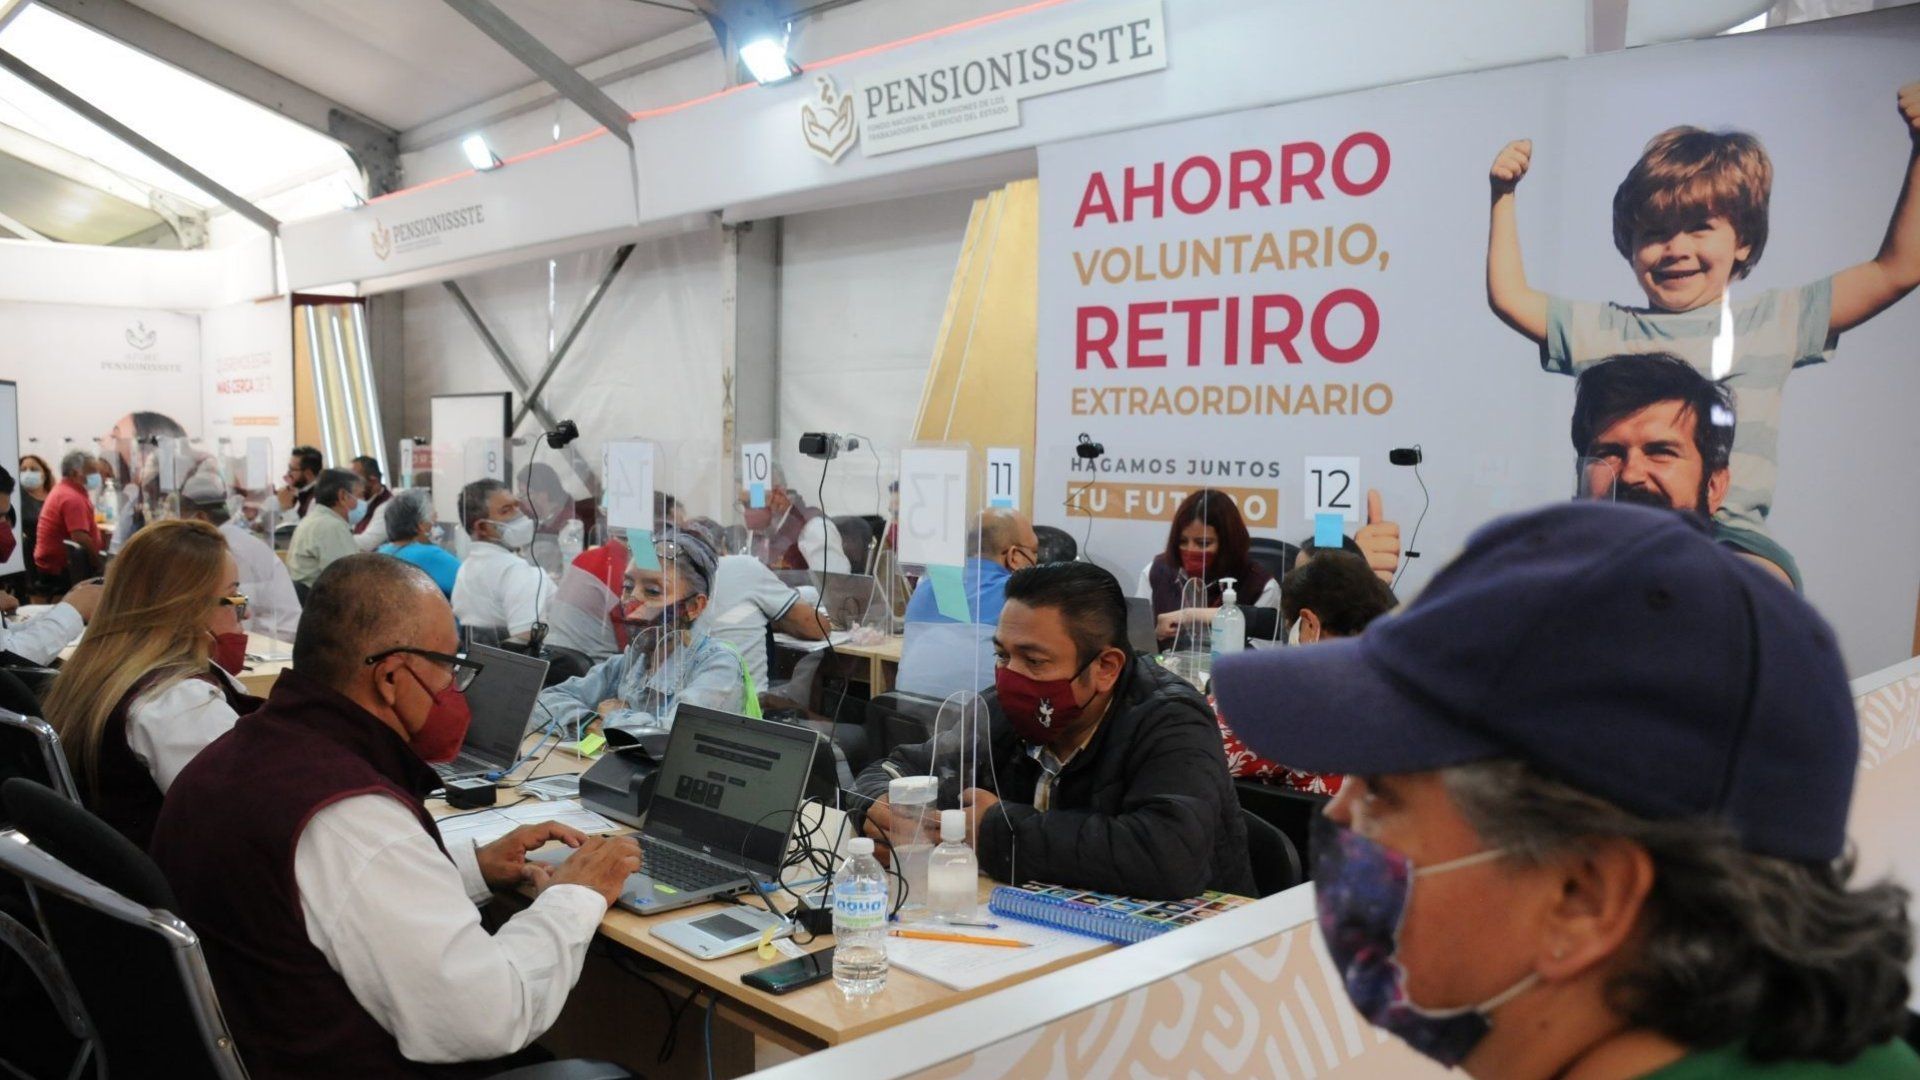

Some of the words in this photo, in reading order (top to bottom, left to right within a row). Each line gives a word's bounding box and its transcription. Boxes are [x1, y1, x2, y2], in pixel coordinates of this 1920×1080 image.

[863, 17, 1154, 120] PENSIONISSSTE
[964, 112, 979, 122] DEL
[979, 105, 1009, 119] ESTADO
[990, 96, 1006, 107] LOS
[1072, 131, 1391, 228] AHORRO
[392, 204, 485, 243] PENSIONISSSTE
[1072, 222, 1390, 286] VOLUNTARIO,
[1075, 287, 1380, 370] RETIRO
[1070, 383, 1394, 416] EXTRAORDINARIO
[486, 451, 497, 473] 8
[744, 452, 768, 481] 10
[990, 462, 1012, 496] 11
[1071, 457, 1177, 475] HAGAMOS
[1187, 460, 1281, 478] JUNTOS
[1069, 487, 1108, 512] TU
[1125, 489, 1268, 522] FUTO
[1310, 469, 1352, 510] 12
